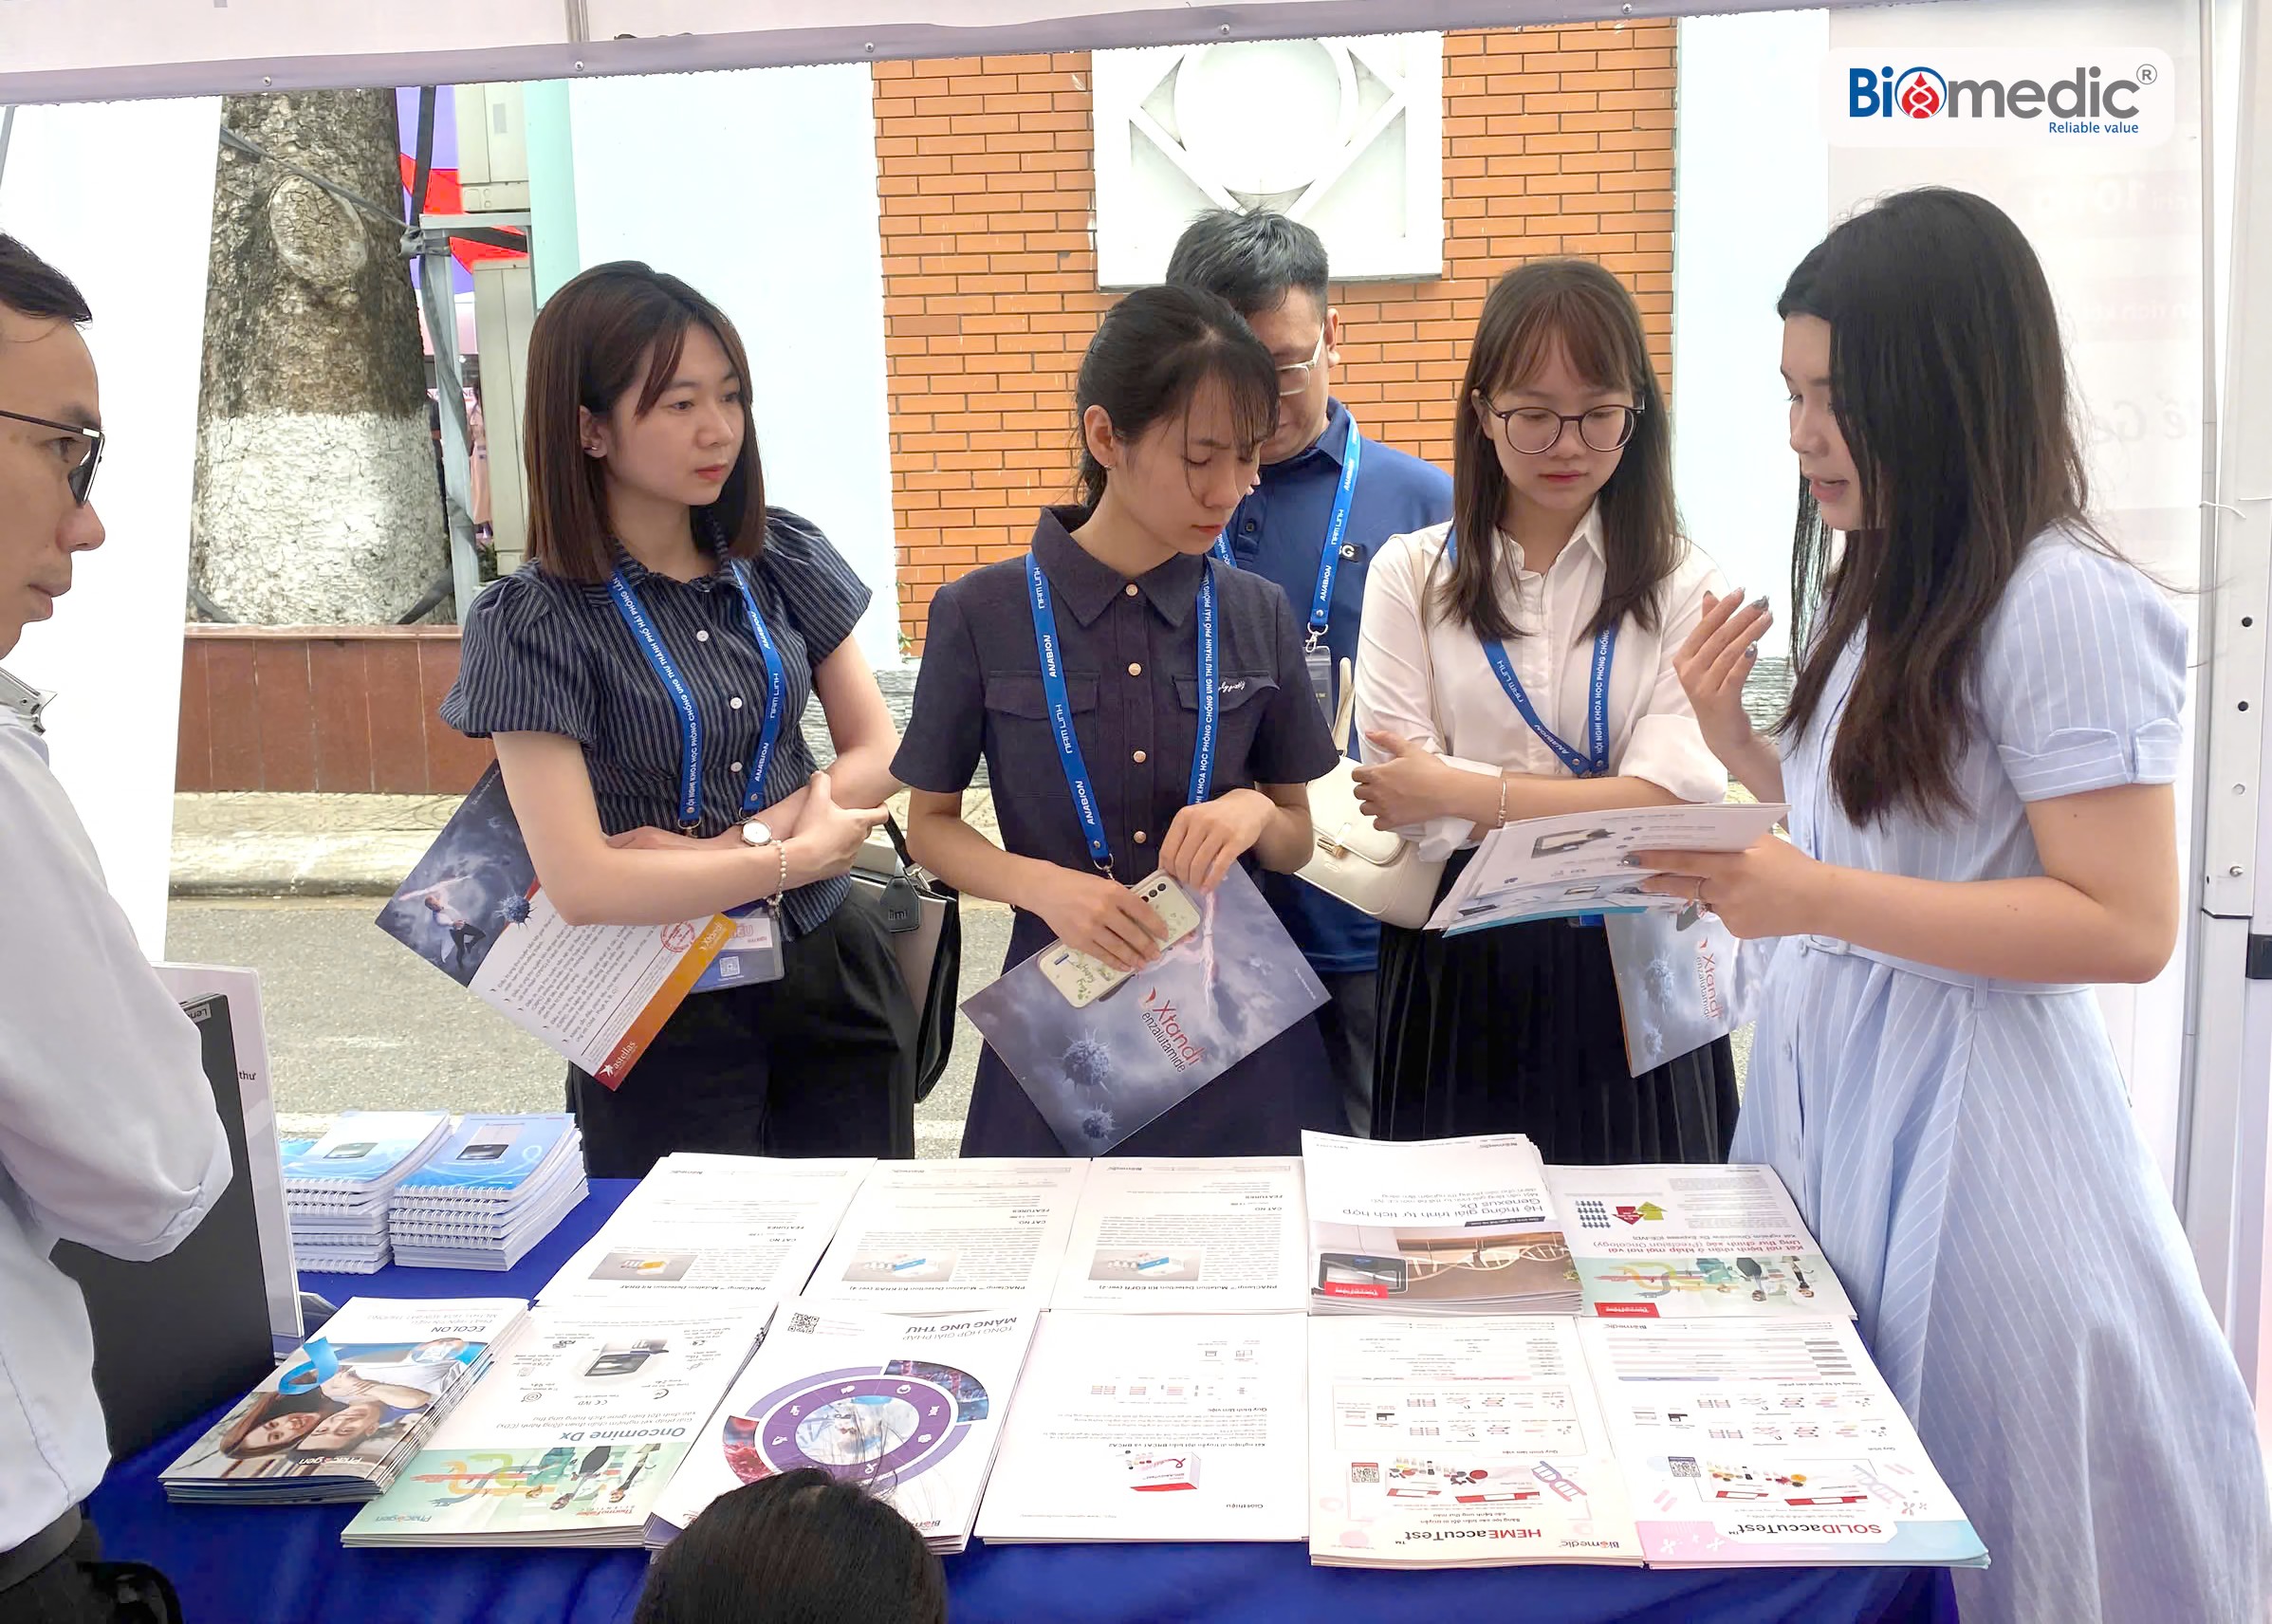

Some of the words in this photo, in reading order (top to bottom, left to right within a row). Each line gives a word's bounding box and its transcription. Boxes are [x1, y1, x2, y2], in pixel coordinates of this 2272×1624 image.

[1321, 564, 1332, 601] ANABION
[639, 627, 656, 647] PHỐ
[1203, 621, 1212, 637] PHỐ
[1599, 629, 1610, 655] CHỐNG
[1043, 634, 1058, 678] ANABION
[1204, 638, 1212, 662] THÀNH
[1205, 662, 1213, 677] THƯ
[1596, 655, 1606, 681] PHÒNG
[1205, 679, 1213, 693] UNG
[1595, 681, 1603, 699] HỌC
[680, 694, 694, 722] CHỐNG
[1204, 694, 1213, 723] CHỐNG
[1594, 700, 1602, 721] KHOA
[1202, 724, 1212, 752] PHÒNG
[1534, 724, 1570, 754] ANABION
[1595, 722, 1604, 742] NGHỊ
[754, 742, 769, 783] ANABION
[1199, 753, 1210, 774] HỌC
[1196, 773, 1207, 795] KHOA
[1075, 780, 1096, 825] ANABION
[1702, 952, 1724, 1020] Xtandi
[1140, 1010, 1188, 1074] enzalutamide
[1152, 999, 1208, 1066] Xtandi
[611, 1041, 637, 1070] astellas
[1481, 1198, 1541, 1207] Genexus
[559, 1432, 585, 1442] Dx
[588, 1428, 687, 1441] Oncomine
